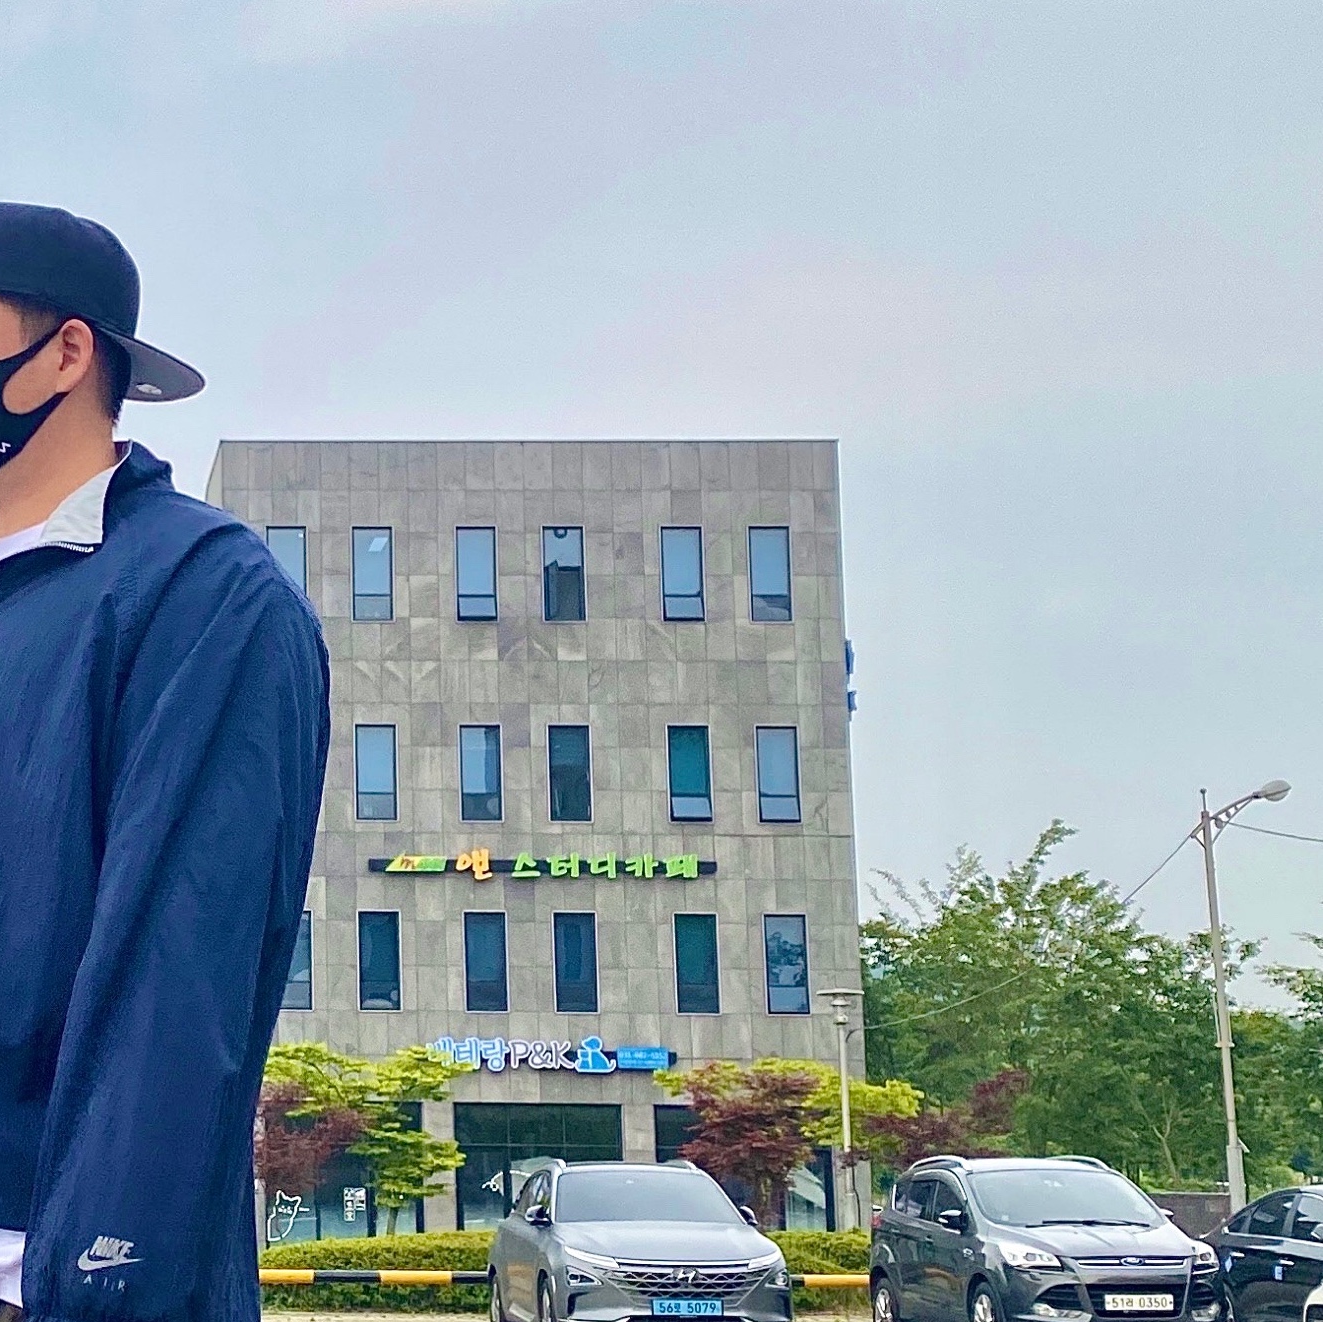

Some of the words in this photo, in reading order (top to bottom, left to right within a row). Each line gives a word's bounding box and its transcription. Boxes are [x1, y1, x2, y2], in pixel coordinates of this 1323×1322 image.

[511, 852, 698, 879] 스터디카페
[90, 1235, 134, 1260] NIKE
[83, 1274, 125, 1292] AIR
[687, 1302, 717, 1313] 5079
[1139, 1297, 1168, 1308] 0350
